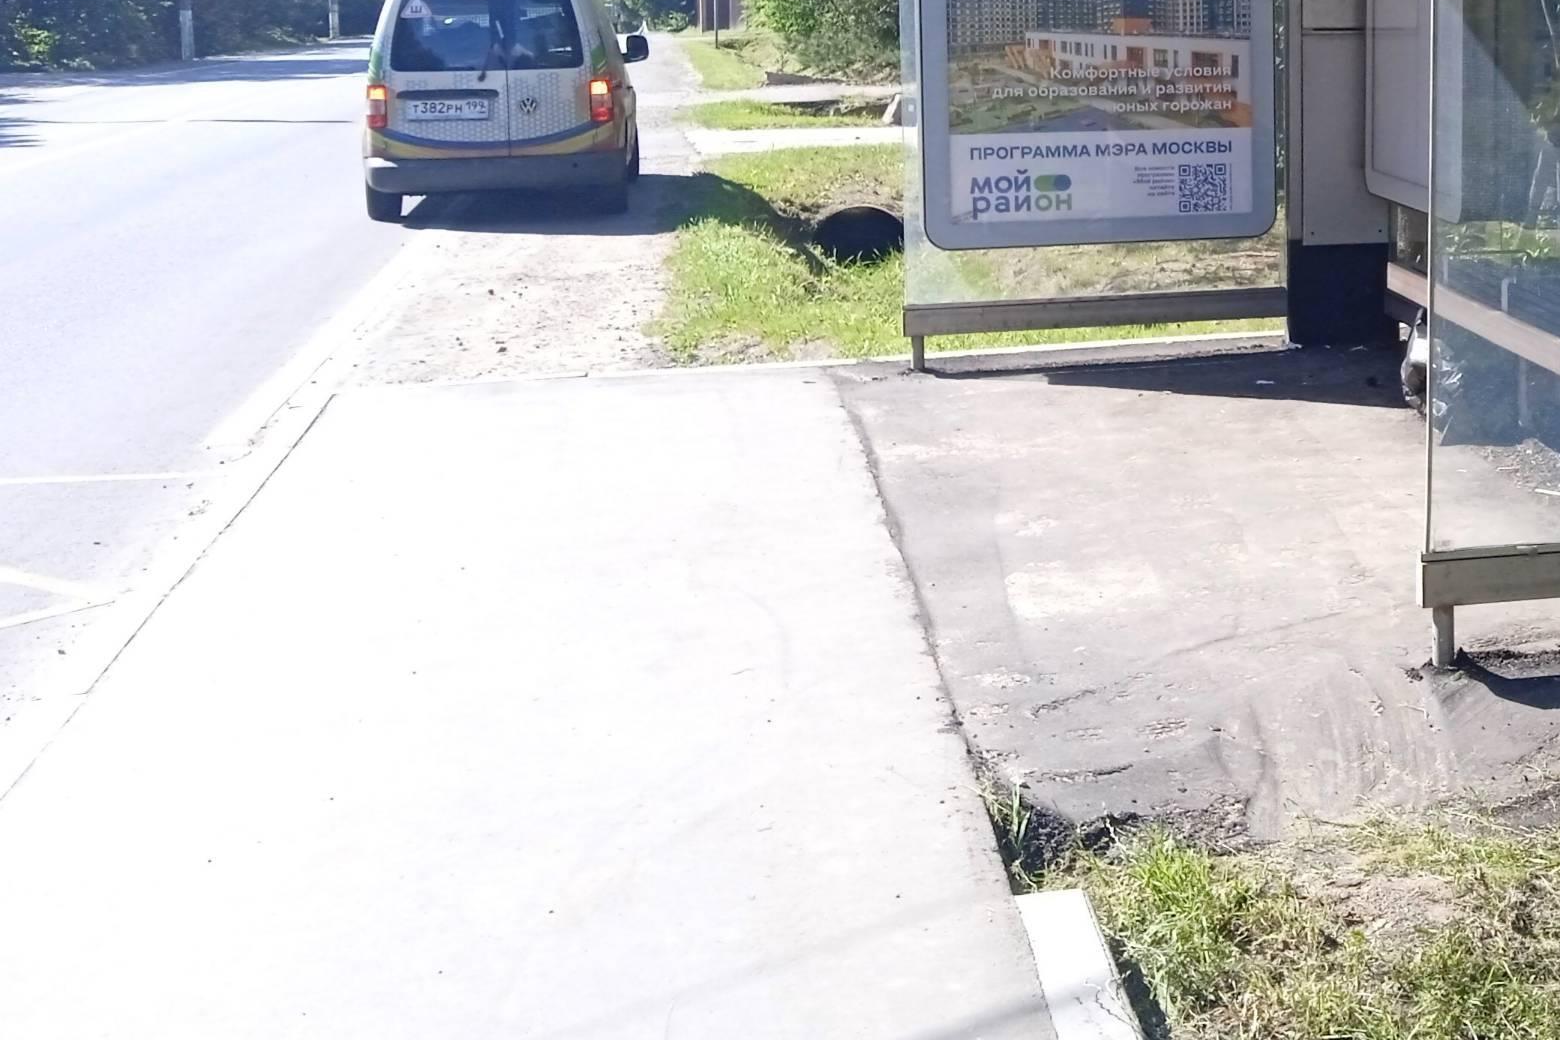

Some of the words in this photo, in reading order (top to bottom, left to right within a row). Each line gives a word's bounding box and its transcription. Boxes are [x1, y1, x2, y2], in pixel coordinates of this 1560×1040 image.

[1050, 66, 1160, 82] Комфортные
[991, 87, 1024, 100] для
[1028, 84, 1137, 99] образования
[1155, 83, 1232, 96] развития
[1112, 102, 1158, 113] юных
[1162, 100, 1232, 114] горожан
[970, 144, 1090, 160] ПРОГРАММА
[1095, 142, 1148, 156] МЭРА
[1152, 140, 1232, 155] МОСКВЫ
[970, 168, 1031, 195] мой
